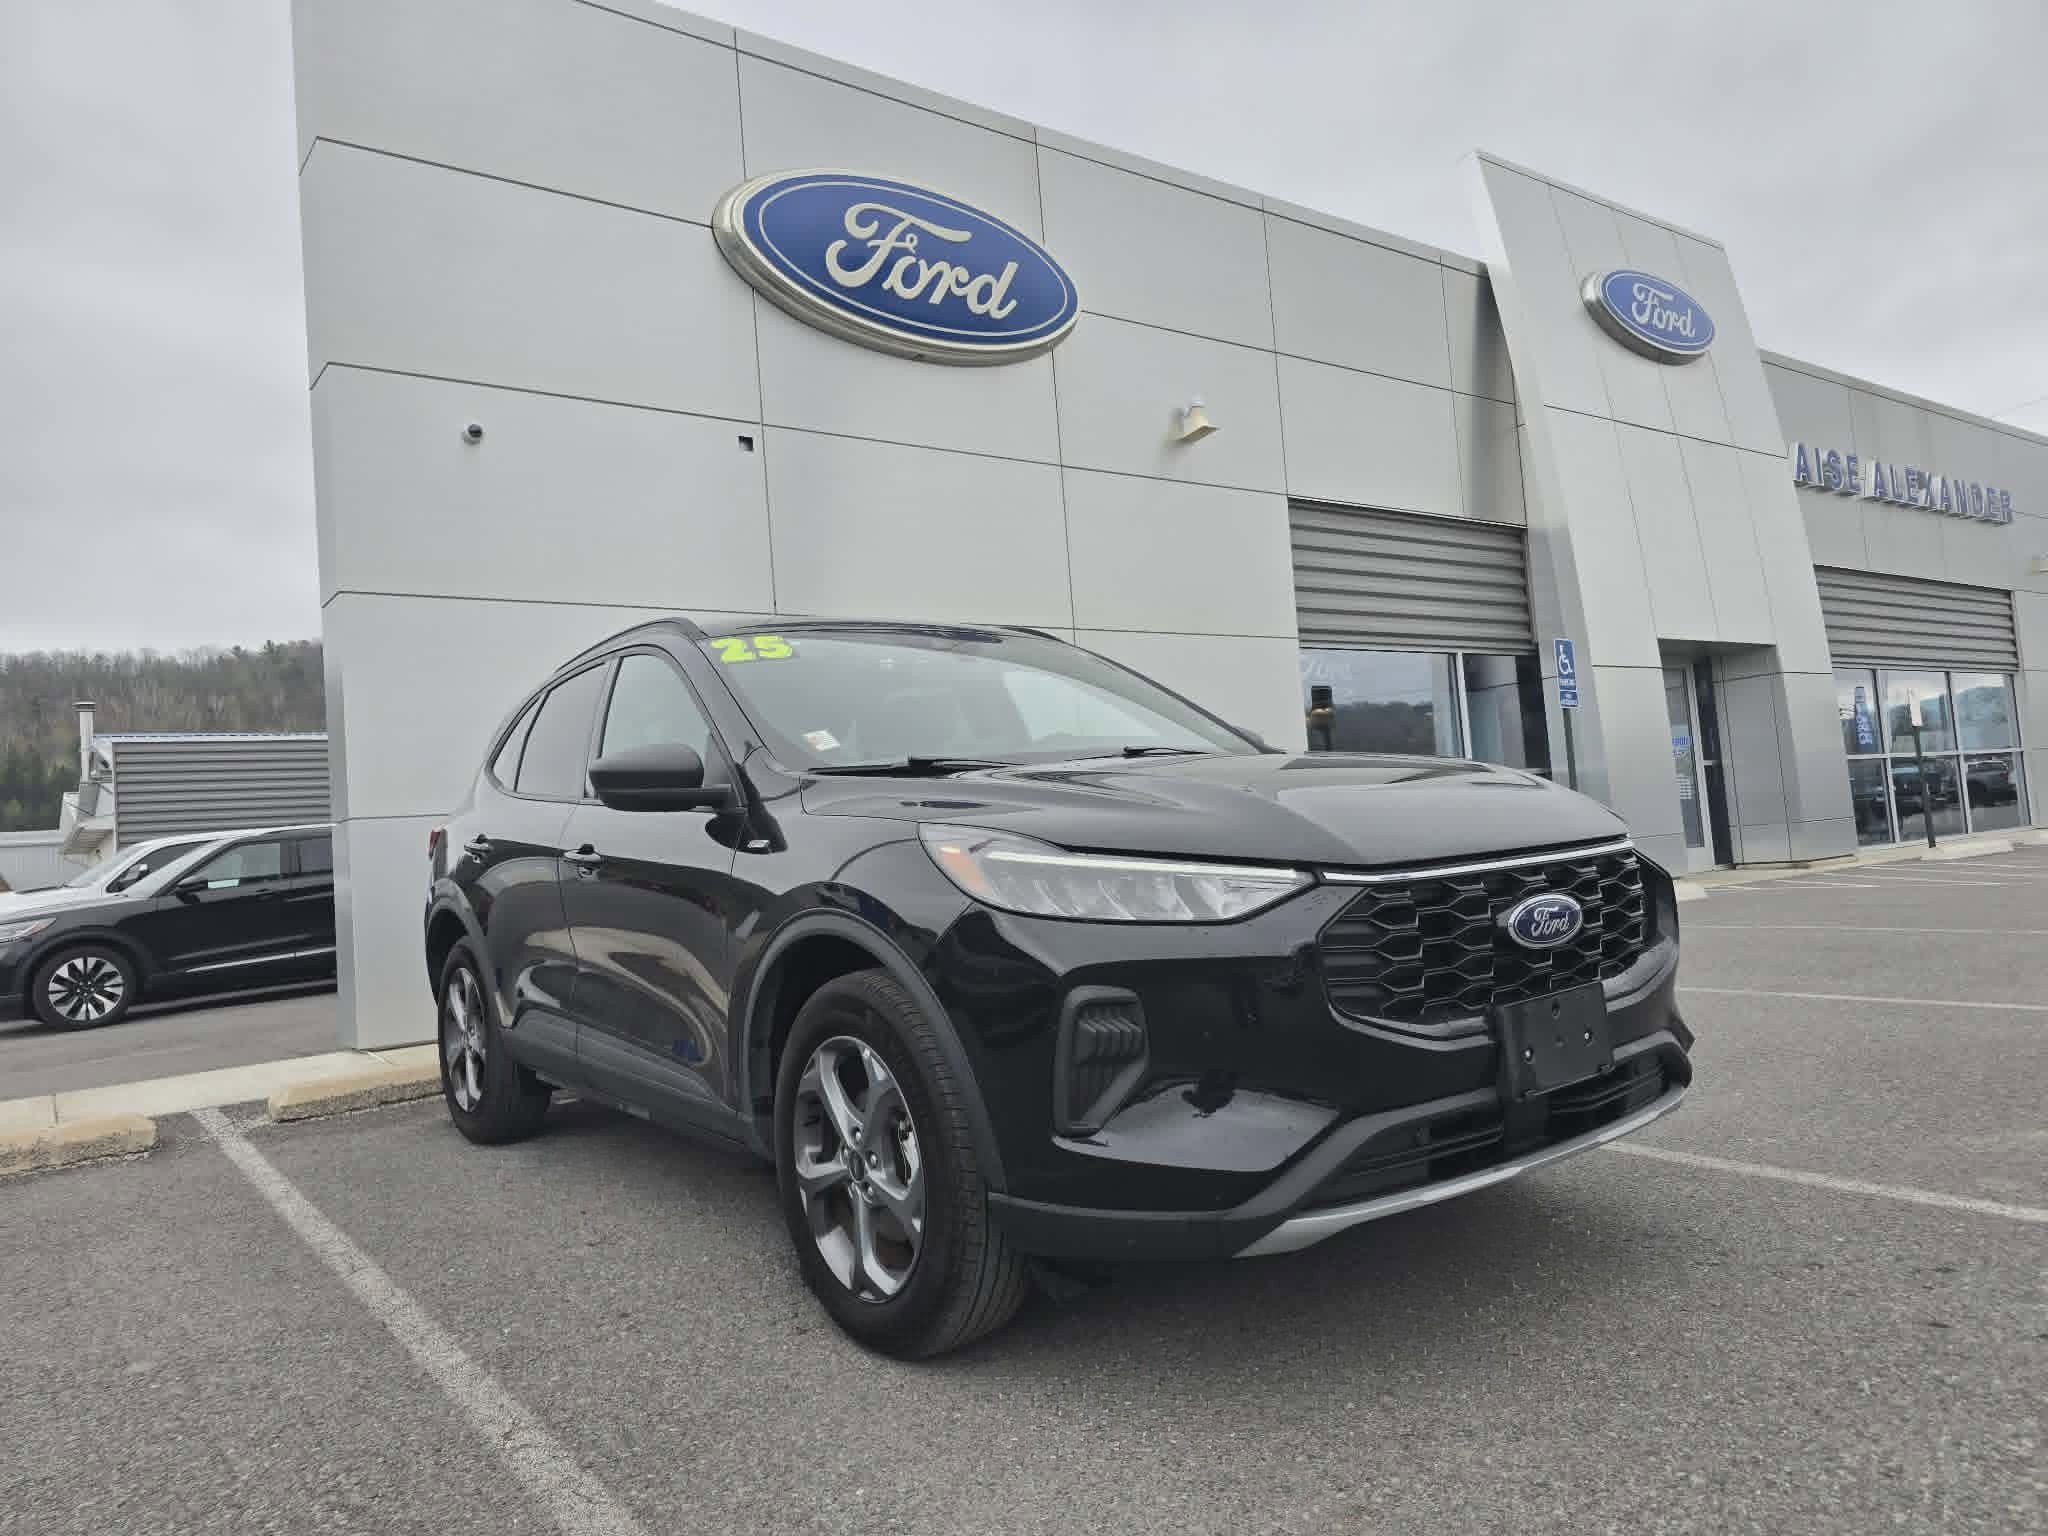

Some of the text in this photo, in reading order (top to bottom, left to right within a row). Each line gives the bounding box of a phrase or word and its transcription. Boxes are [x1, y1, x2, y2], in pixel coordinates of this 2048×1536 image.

[825, 202, 1018, 320] Ford
[1632, 283, 1695, 337] Ford
[1870, 460, 2014, 523] ALEXANDER
[710, 634, 793, 664] 25
[1531, 906, 1570, 936] Ford
